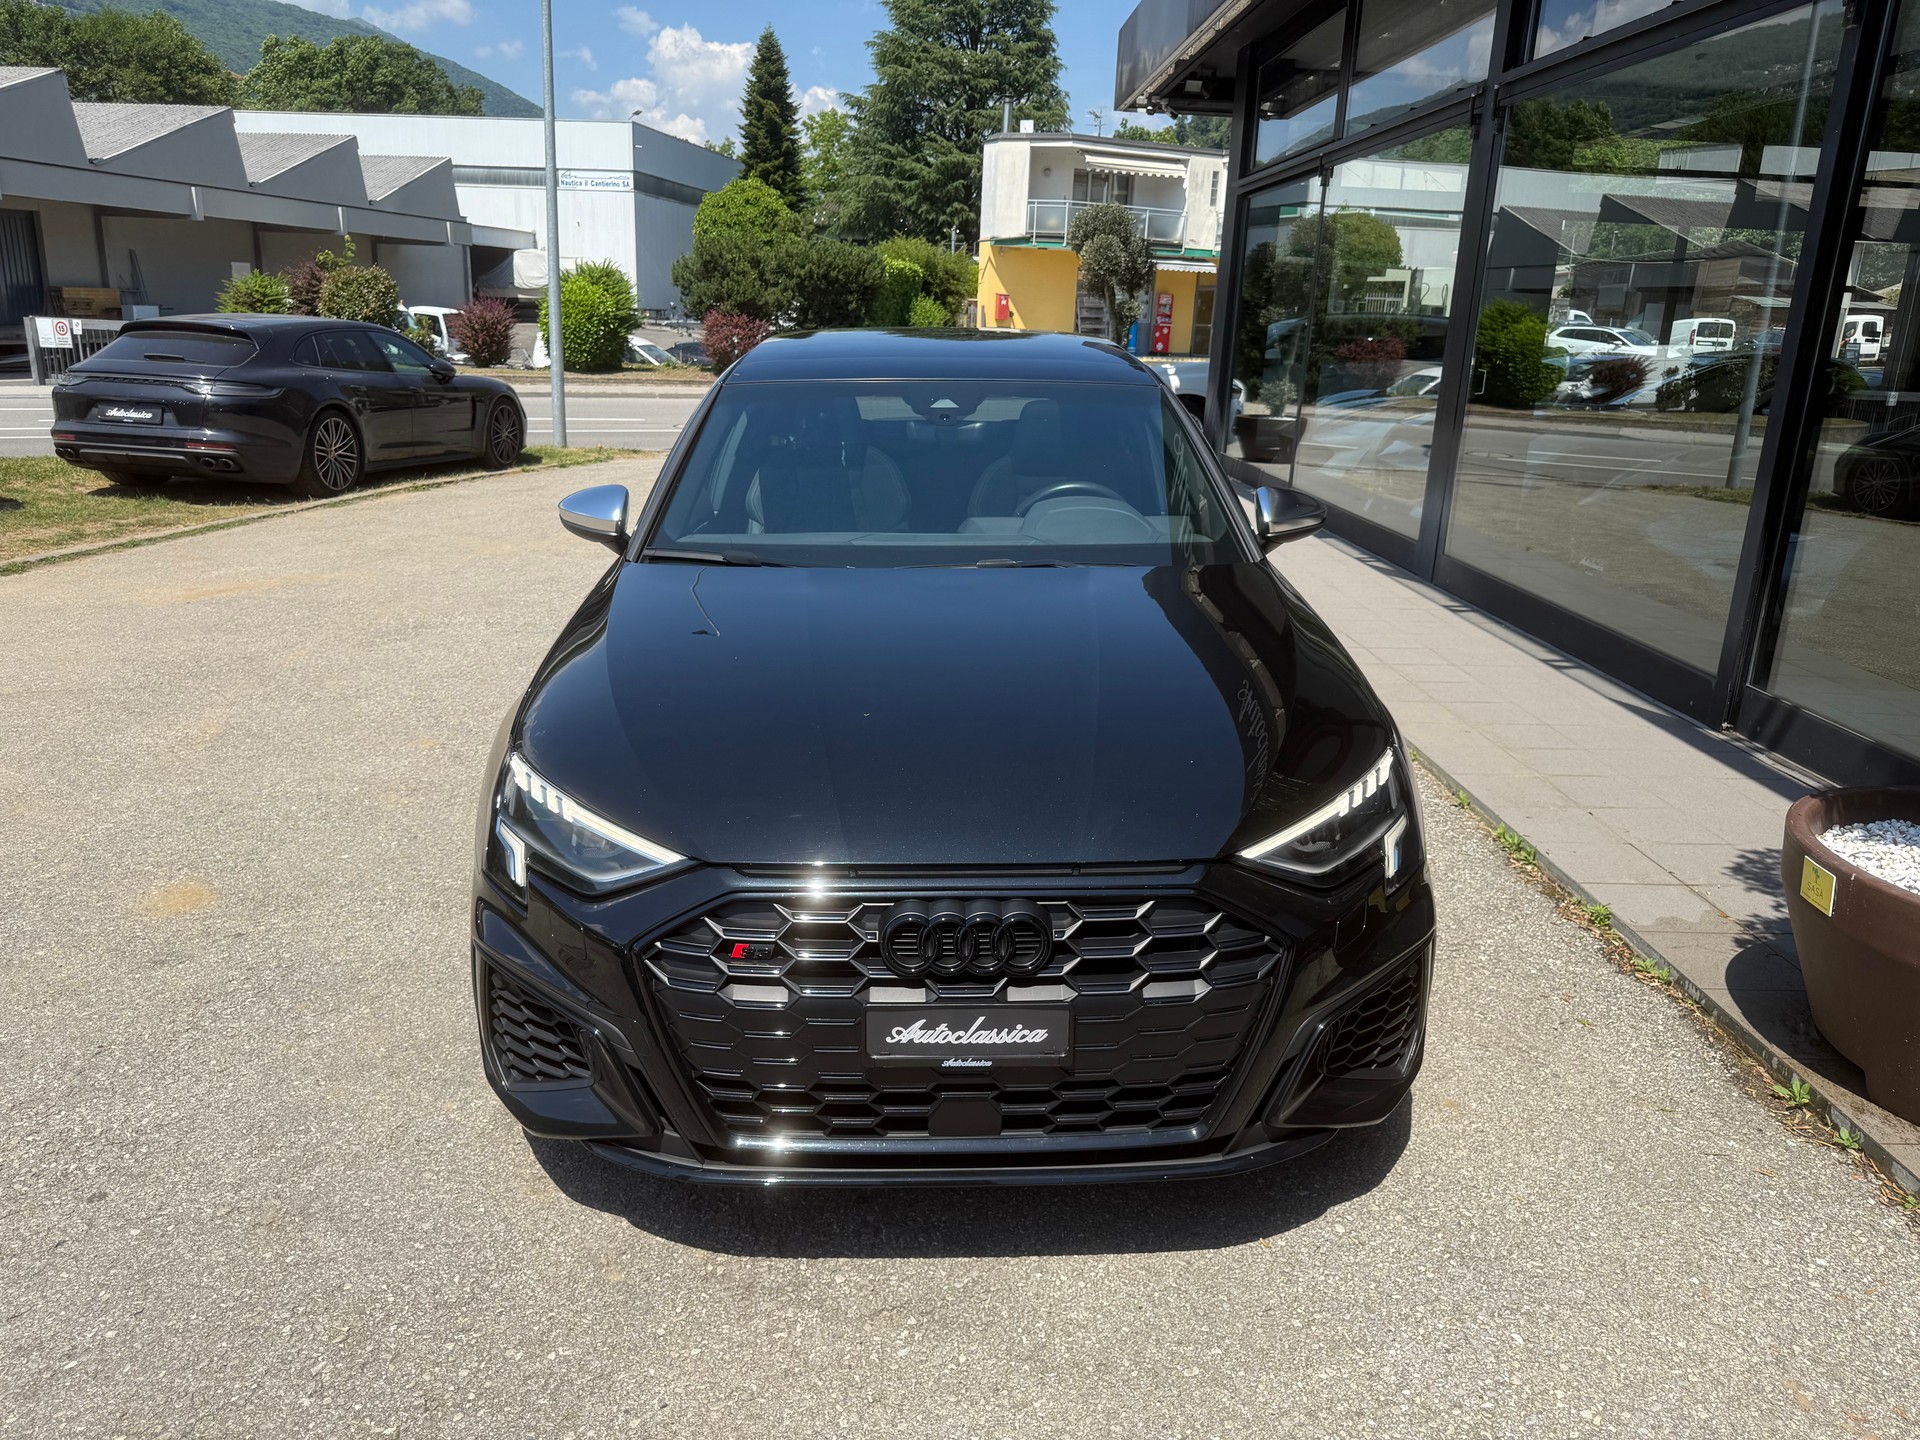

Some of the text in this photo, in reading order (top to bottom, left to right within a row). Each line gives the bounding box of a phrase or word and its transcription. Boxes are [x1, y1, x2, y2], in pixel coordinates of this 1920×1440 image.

[561, 179, 582, 187] Nautica
[590, 180, 620, 188] Cantierino
[105, 407, 153, 419] Autoclassica
[886, 1016, 1048, 1044] Autoclassica
[941, 1057, 993, 1068] Autoclassica
